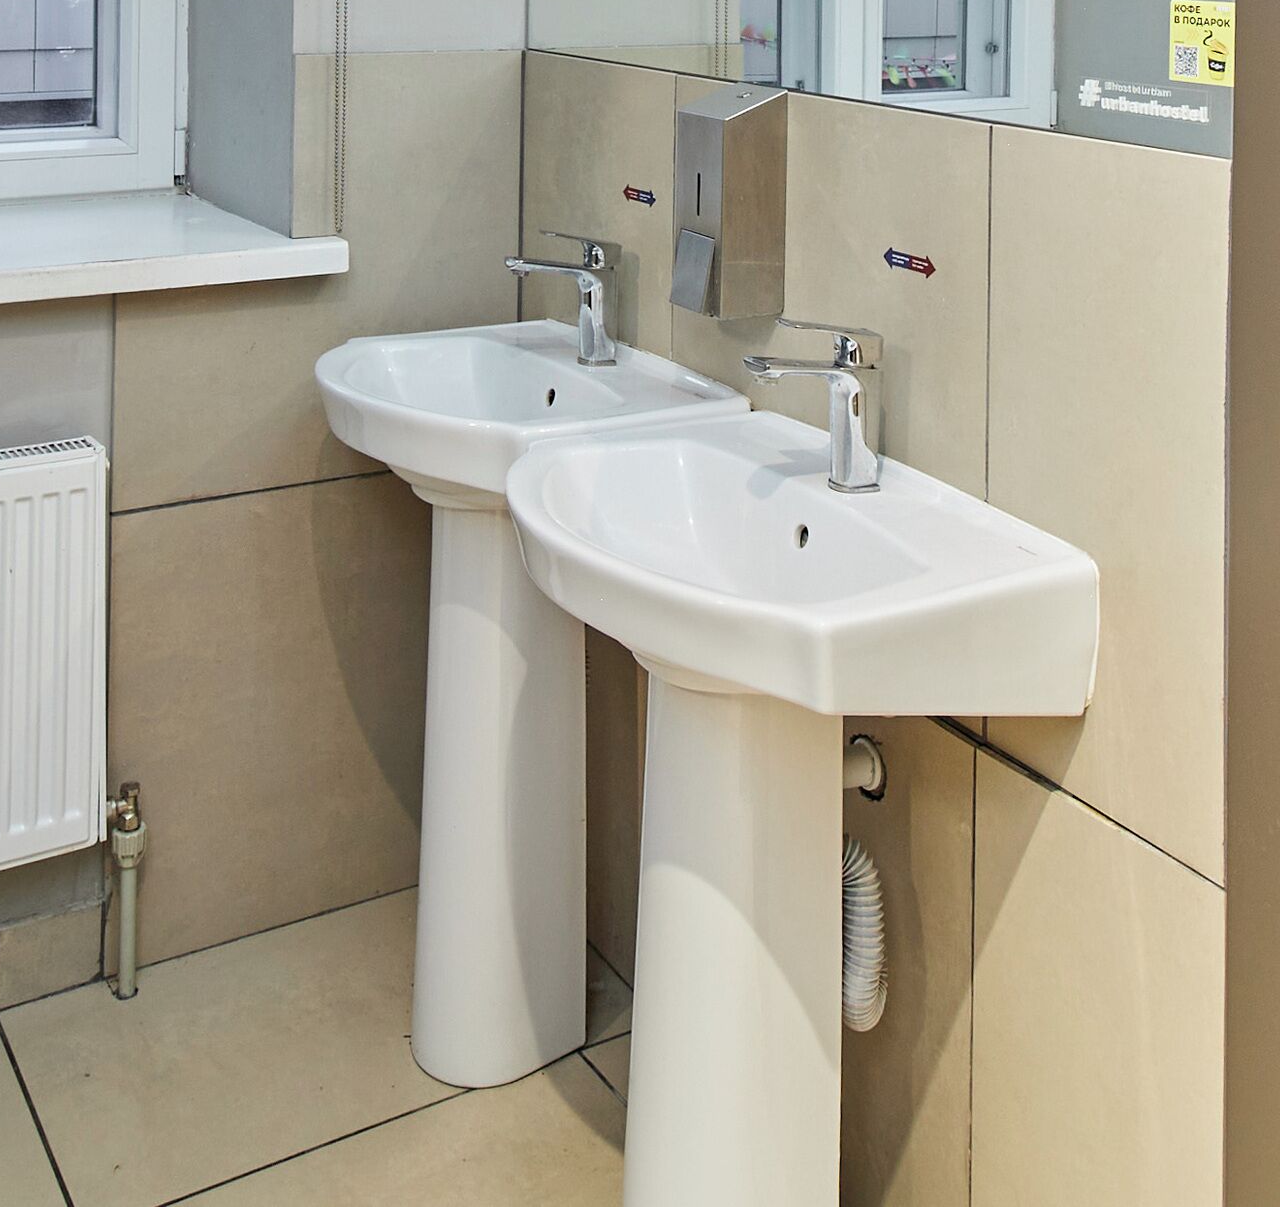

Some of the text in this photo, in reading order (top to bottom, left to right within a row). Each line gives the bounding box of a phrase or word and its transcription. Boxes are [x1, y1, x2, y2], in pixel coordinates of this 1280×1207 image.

[1174, 4, 1201, 14] КОФЕ
[1174, 16, 1230, 27] В ПОДАРОК
